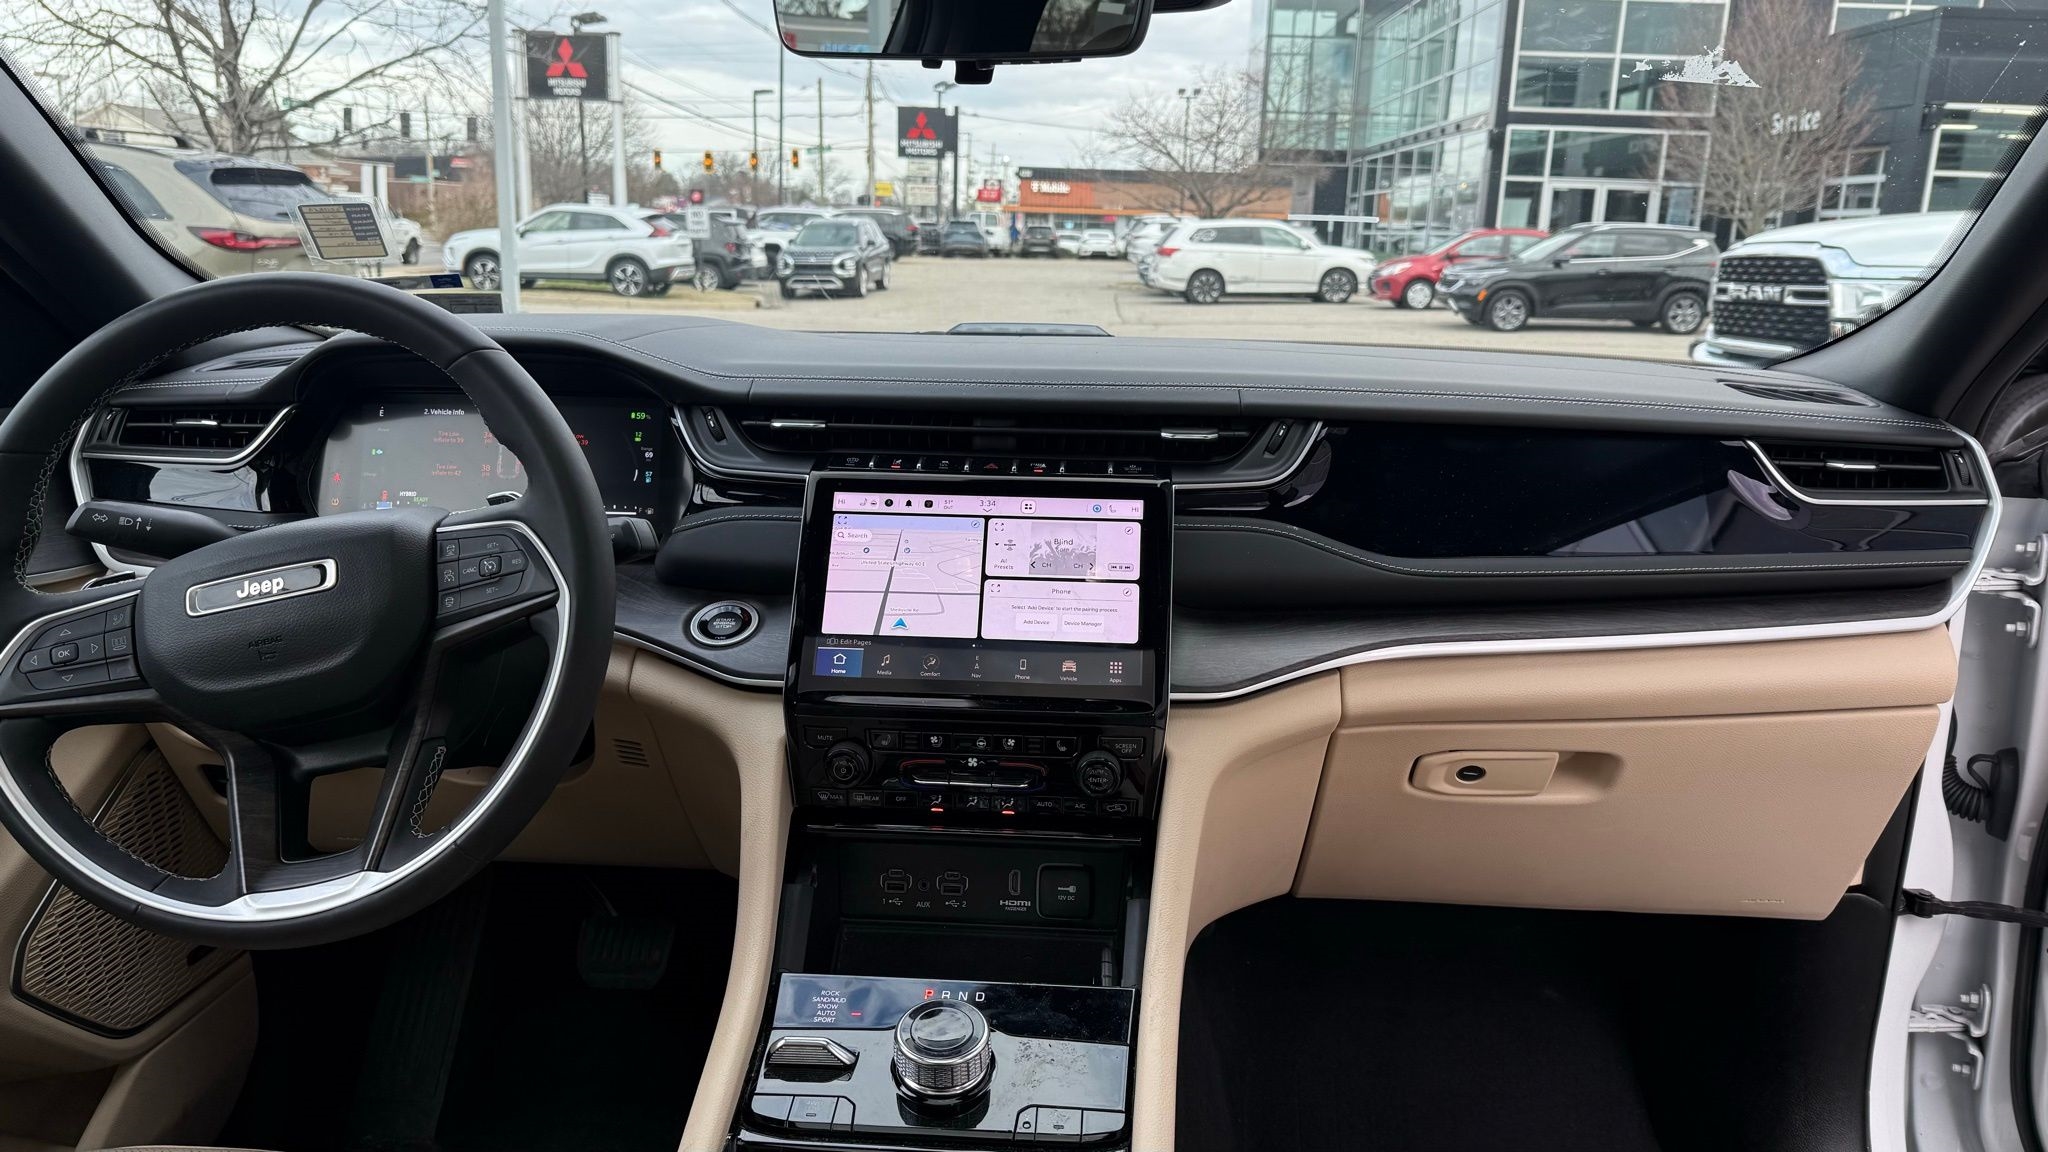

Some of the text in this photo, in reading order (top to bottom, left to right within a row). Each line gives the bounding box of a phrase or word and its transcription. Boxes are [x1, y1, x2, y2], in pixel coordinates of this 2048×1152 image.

[424, 408, 430, 416] 2.
[430, 408, 452, 416] Vehicle
[979, 499, 996, 507] 3:34
[236, 577, 285, 599] Jeep
[853, 639, 872, 647] Pages
[57, 649, 70, 658] OK
[924, 989, 985, 1001] P R N D
